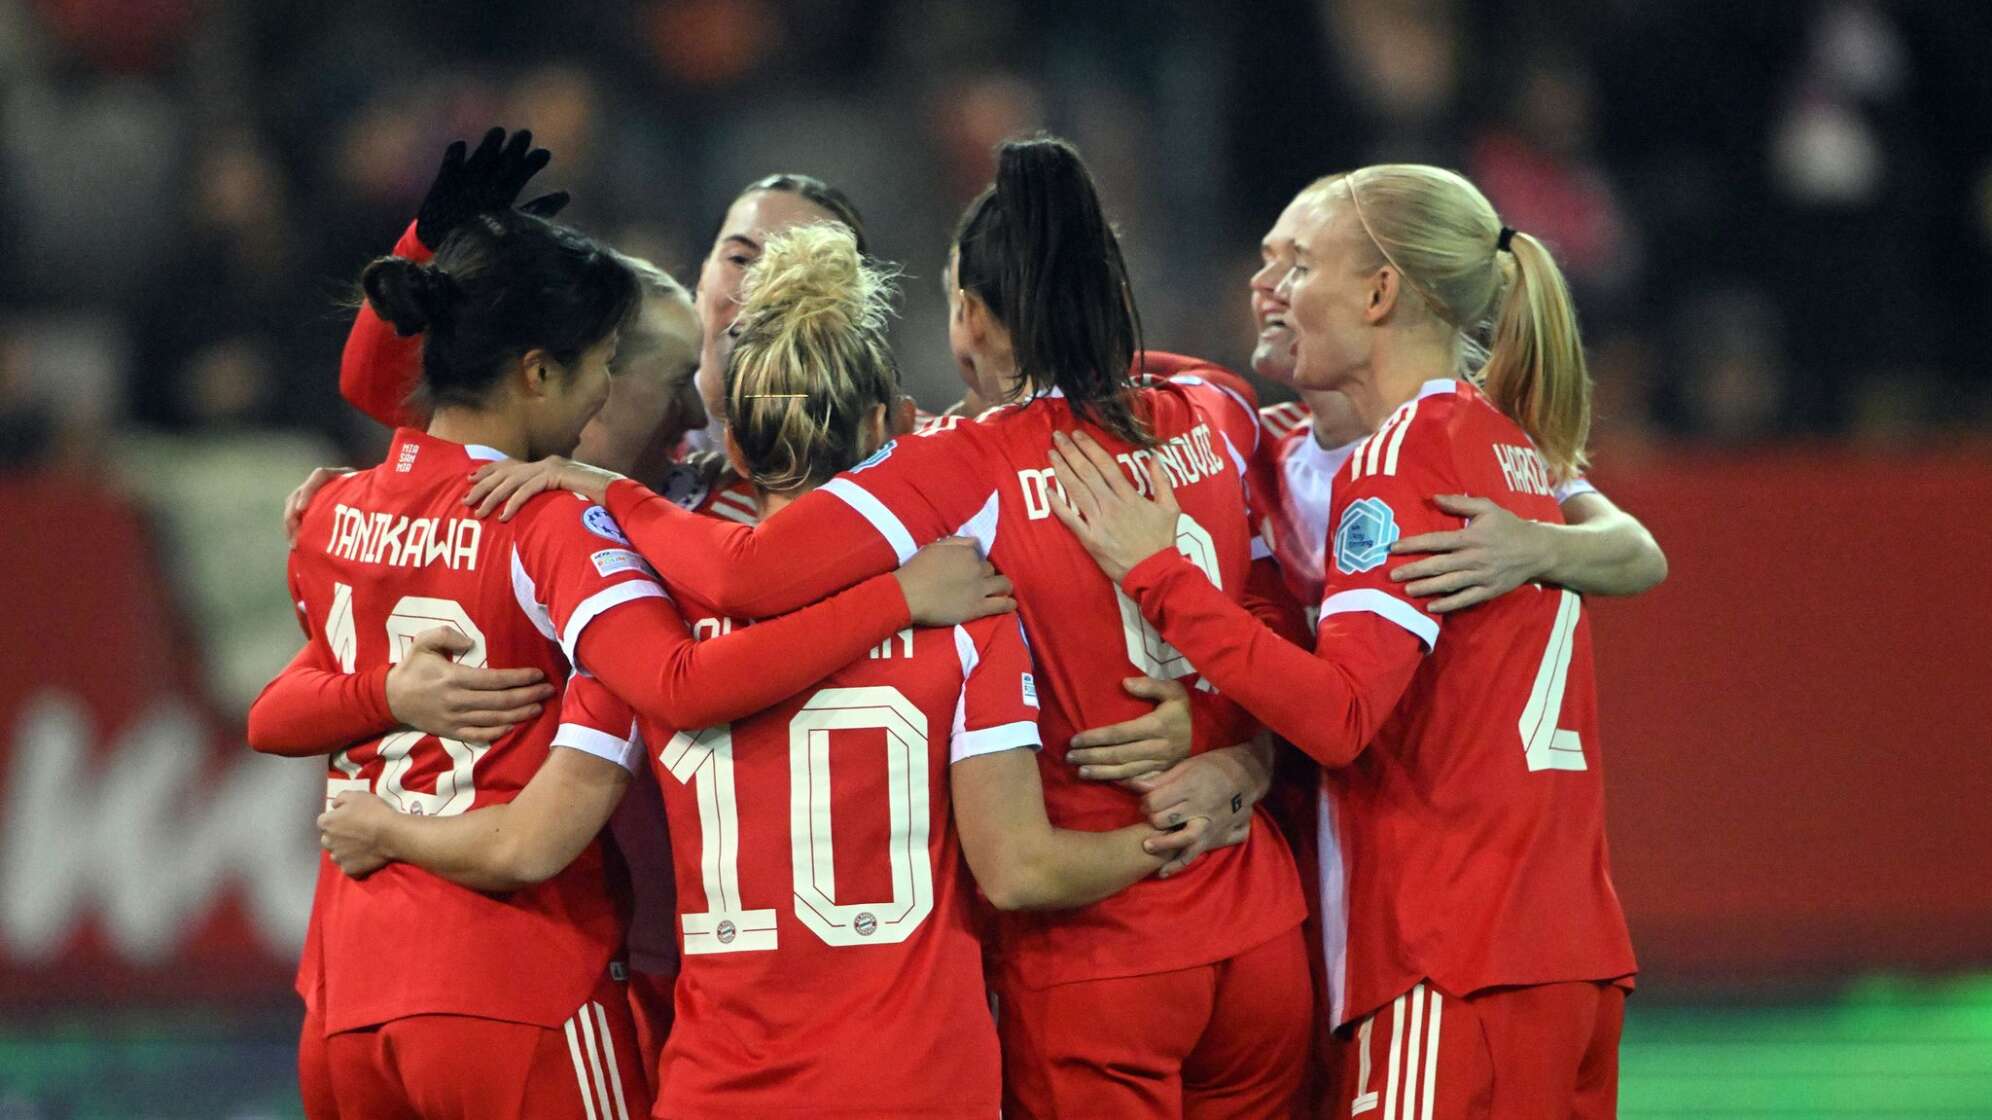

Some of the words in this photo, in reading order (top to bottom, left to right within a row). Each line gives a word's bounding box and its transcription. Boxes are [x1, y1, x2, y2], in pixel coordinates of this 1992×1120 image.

[326, 503, 482, 571] TANIKAWA
[1492, 443, 1554, 497] HARD
[325, 582, 489, 817] 18
[659, 686, 934, 955] 10
